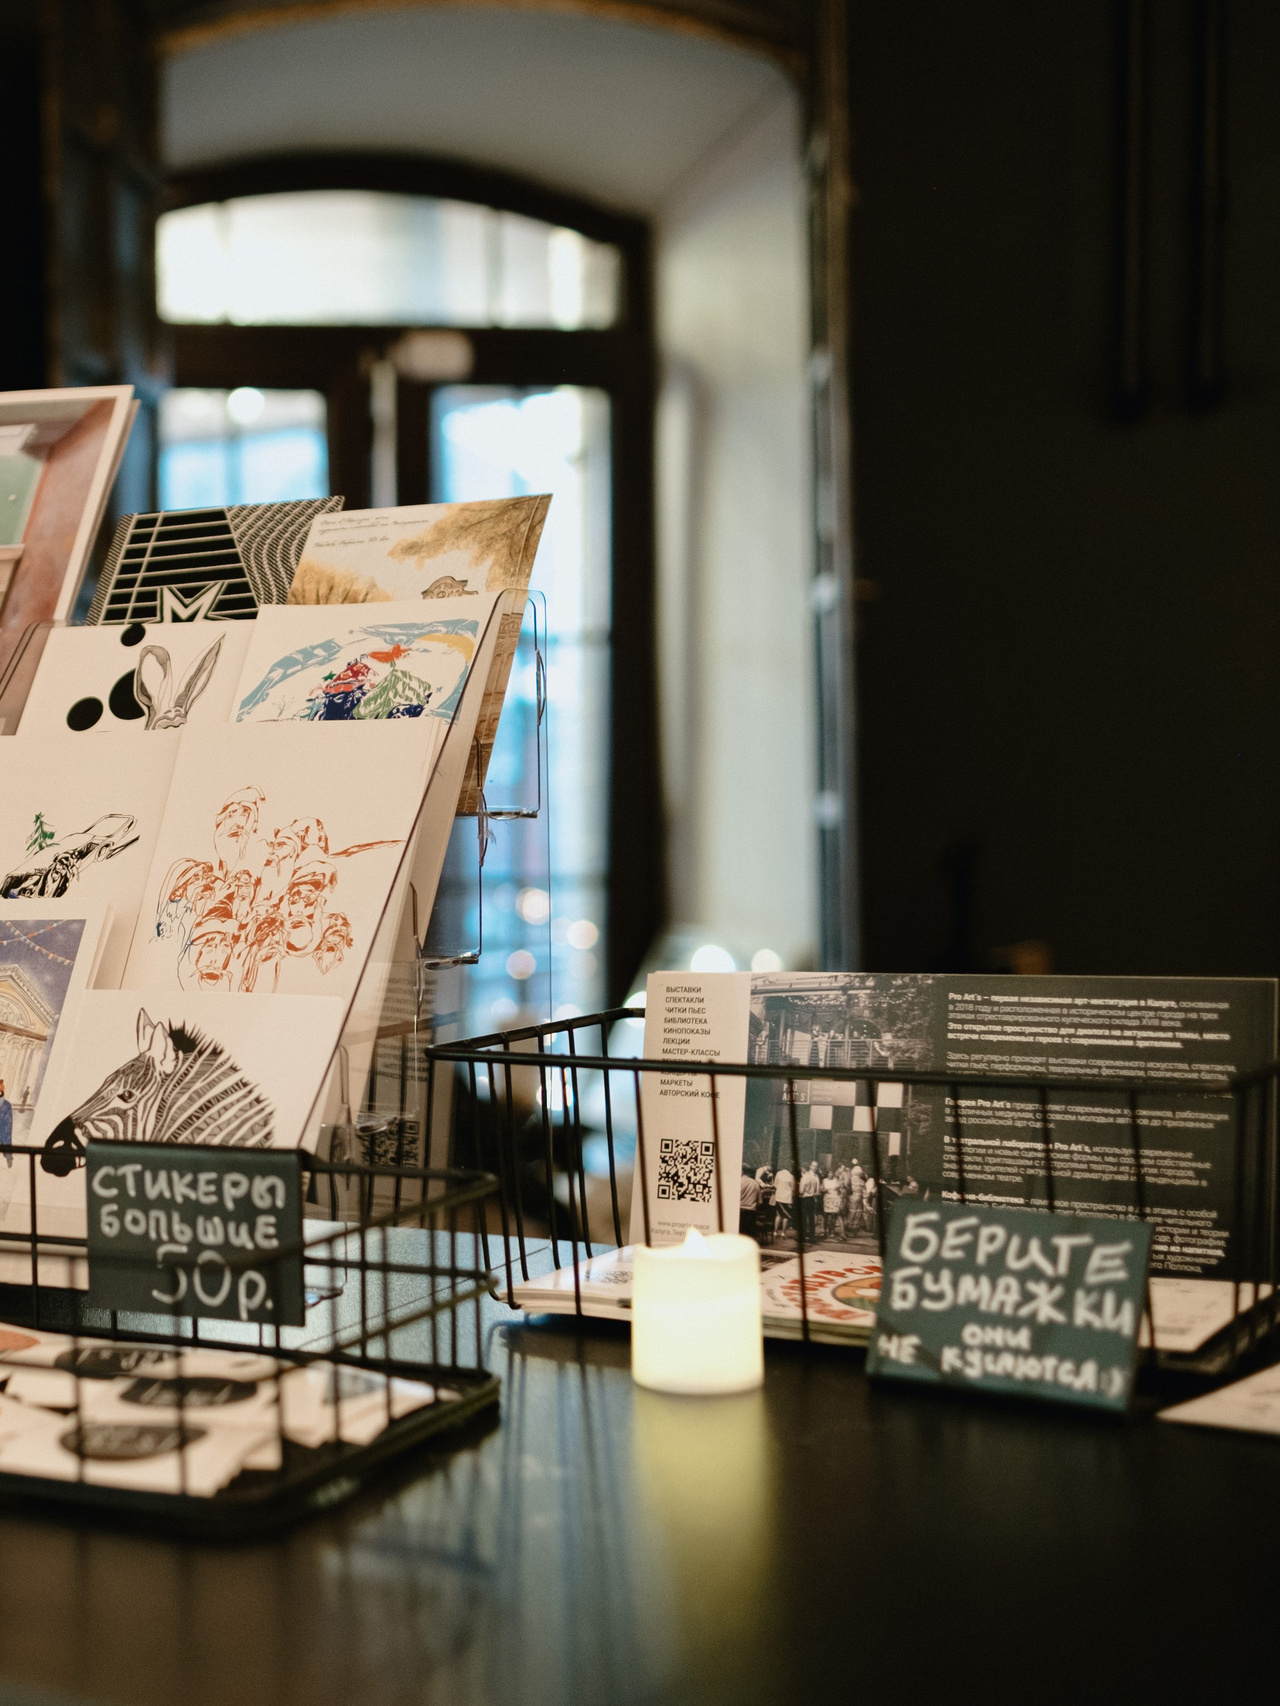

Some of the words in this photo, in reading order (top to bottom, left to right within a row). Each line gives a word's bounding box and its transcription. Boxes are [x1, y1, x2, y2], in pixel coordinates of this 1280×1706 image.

[955, 1003, 973, 1011] 2018
[975, 1005, 991, 1013] году
[663, 1027, 711, 1035] КИНОПОКАЗЫ
[662, 1048, 720, 1056] МАСТЕР-КЛАССЫ
[659, 1089, 699, 1097] АВТОРСКИЙ
[945, 1098, 976, 1107] Гаерея
[977, 1099, 991, 1108] Pro
[1123, 1109, 1173, 1118] хуожников,
[1054, 1142, 1068, 1150] Pro
[900, 1211, 1133, 1284] БЕРИТЕ
[890, 1266, 1134, 1337] БУМАЖКИ
